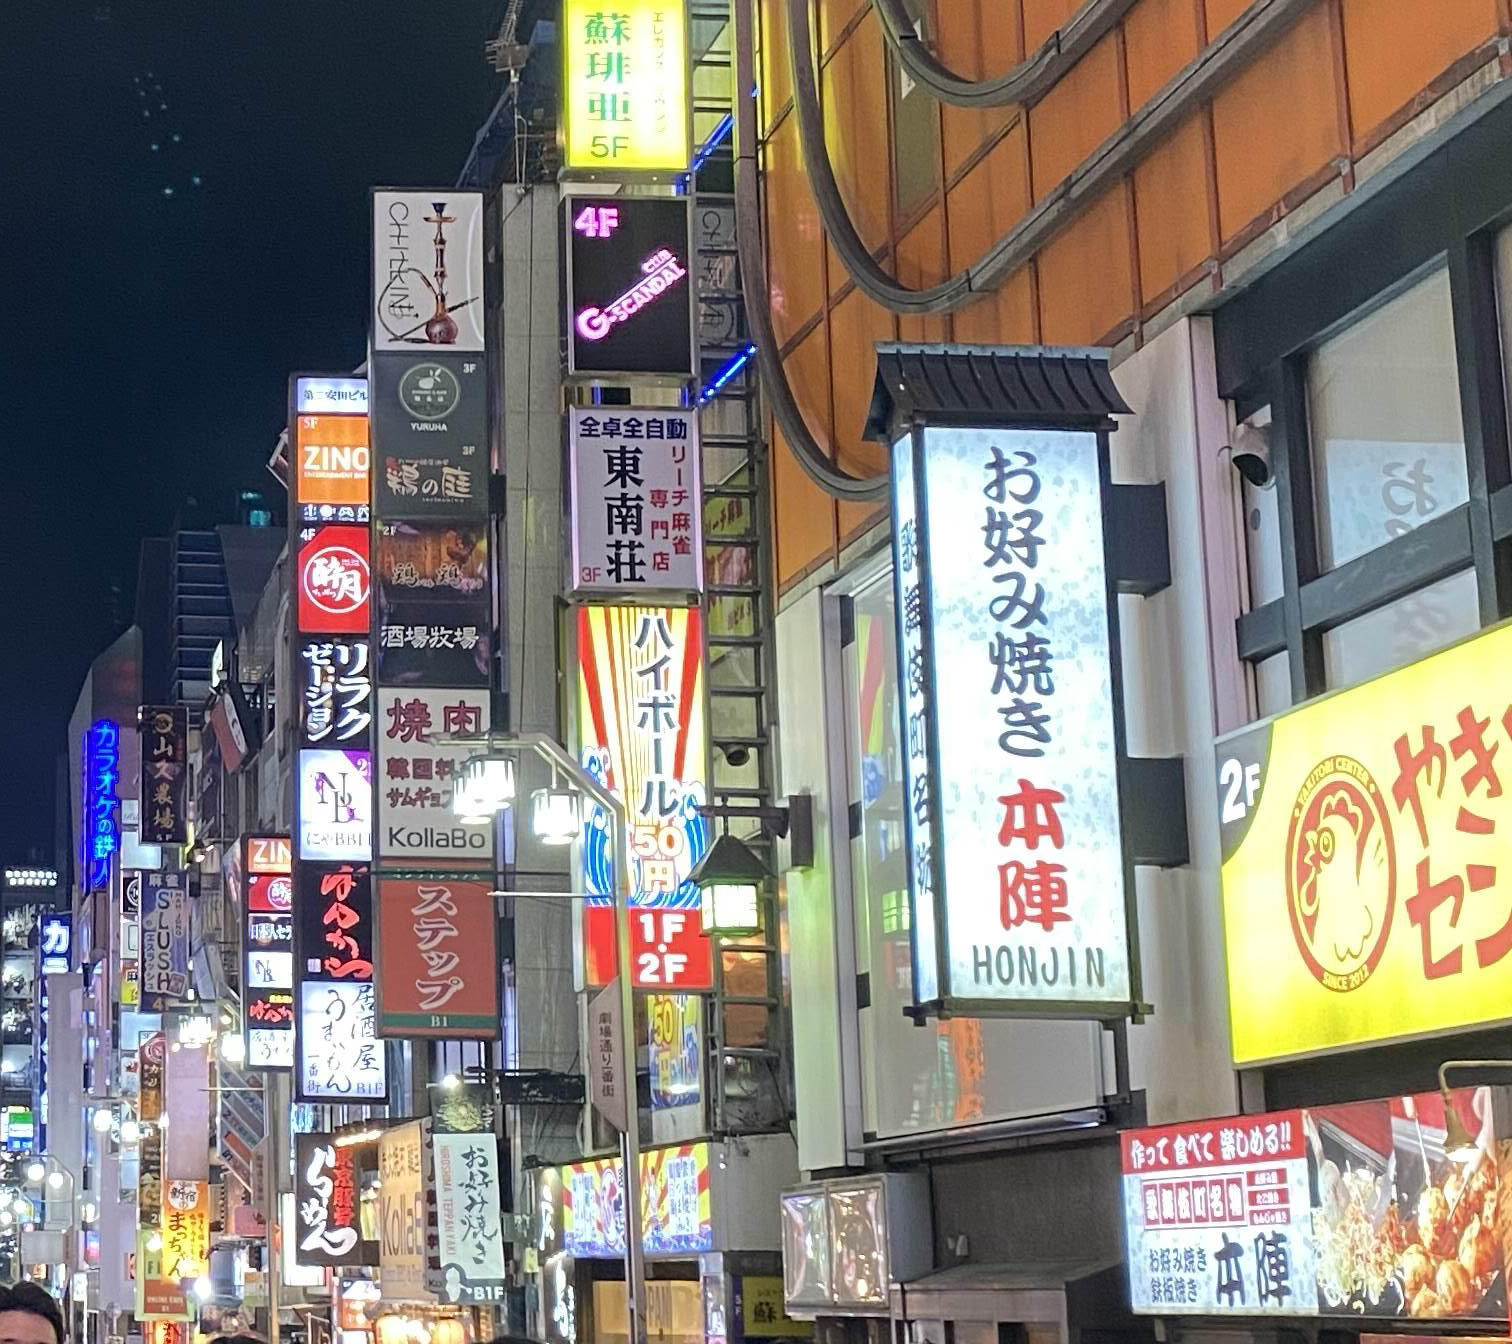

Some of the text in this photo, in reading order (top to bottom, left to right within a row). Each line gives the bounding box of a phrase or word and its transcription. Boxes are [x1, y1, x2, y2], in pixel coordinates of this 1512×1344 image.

[591, 136, 628, 158] 5F
[575, 207, 619, 238] 4F
[463, 363, 476, 373] 3F
[579, 418, 687, 440] 全卓全自動
[304, 447, 369, 470] ZINO
[603, 446, 646, 584] 東南荘
[671, 446, 690, 556] リーチ麻雀
[300, 529, 315, 540] 4F
[649, 489, 669, 572] 専門店
[582, 568, 601, 583] 3F
[982, 447, 1056, 757] お好み焼き
[381, 626, 479, 649] 酒場牧場
[303, 643, 335, 742] ゼーション
[337, 643, 371, 741] リラク
[387, 698, 482, 743] 焼肉
[634, 617, 679, 817] ハイボール
[386, 758, 456, 781] 韓国料
[1298, 758, 1370, 803] YAKITORI CENTER
[1391, 704, 1512, 850] やき
[386, 787, 454, 809] サムギョプ
[1220, 756, 1261, 824] 2F
[254, 842, 292, 862] ZIN
[389, 828, 486, 849] KollaBo
[997, 779, 1073, 932] 本陣
[149, 874, 179, 887] 麻雀
[640, 914, 685, 944] 1F
[411, 886, 464, 1010] ステップ
[639, 953, 687, 983] 2F
[974, 944, 1105, 987] HONJIN
[1322, 971, 1348, 991] SINCE
[431, 1016, 449, 1027] B1
[599, 1012, 614, 1097] 劇場通り一番街
[356, 1083, 383, 1094] B1F
[1131, 1137, 1169, 1169] 作って
[1174, 1132, 1214, 1165] 食べて
[461, 1145, 498, 1265] お好み焼き
[1149, 1247, 1207, 1273] お好み焼き
[1214, 1231, 1292, 1307] 本陣
[474, 1287, 504, 1300] B1F
[1151, 1278, 1197, 1303] 鉄板焼き
